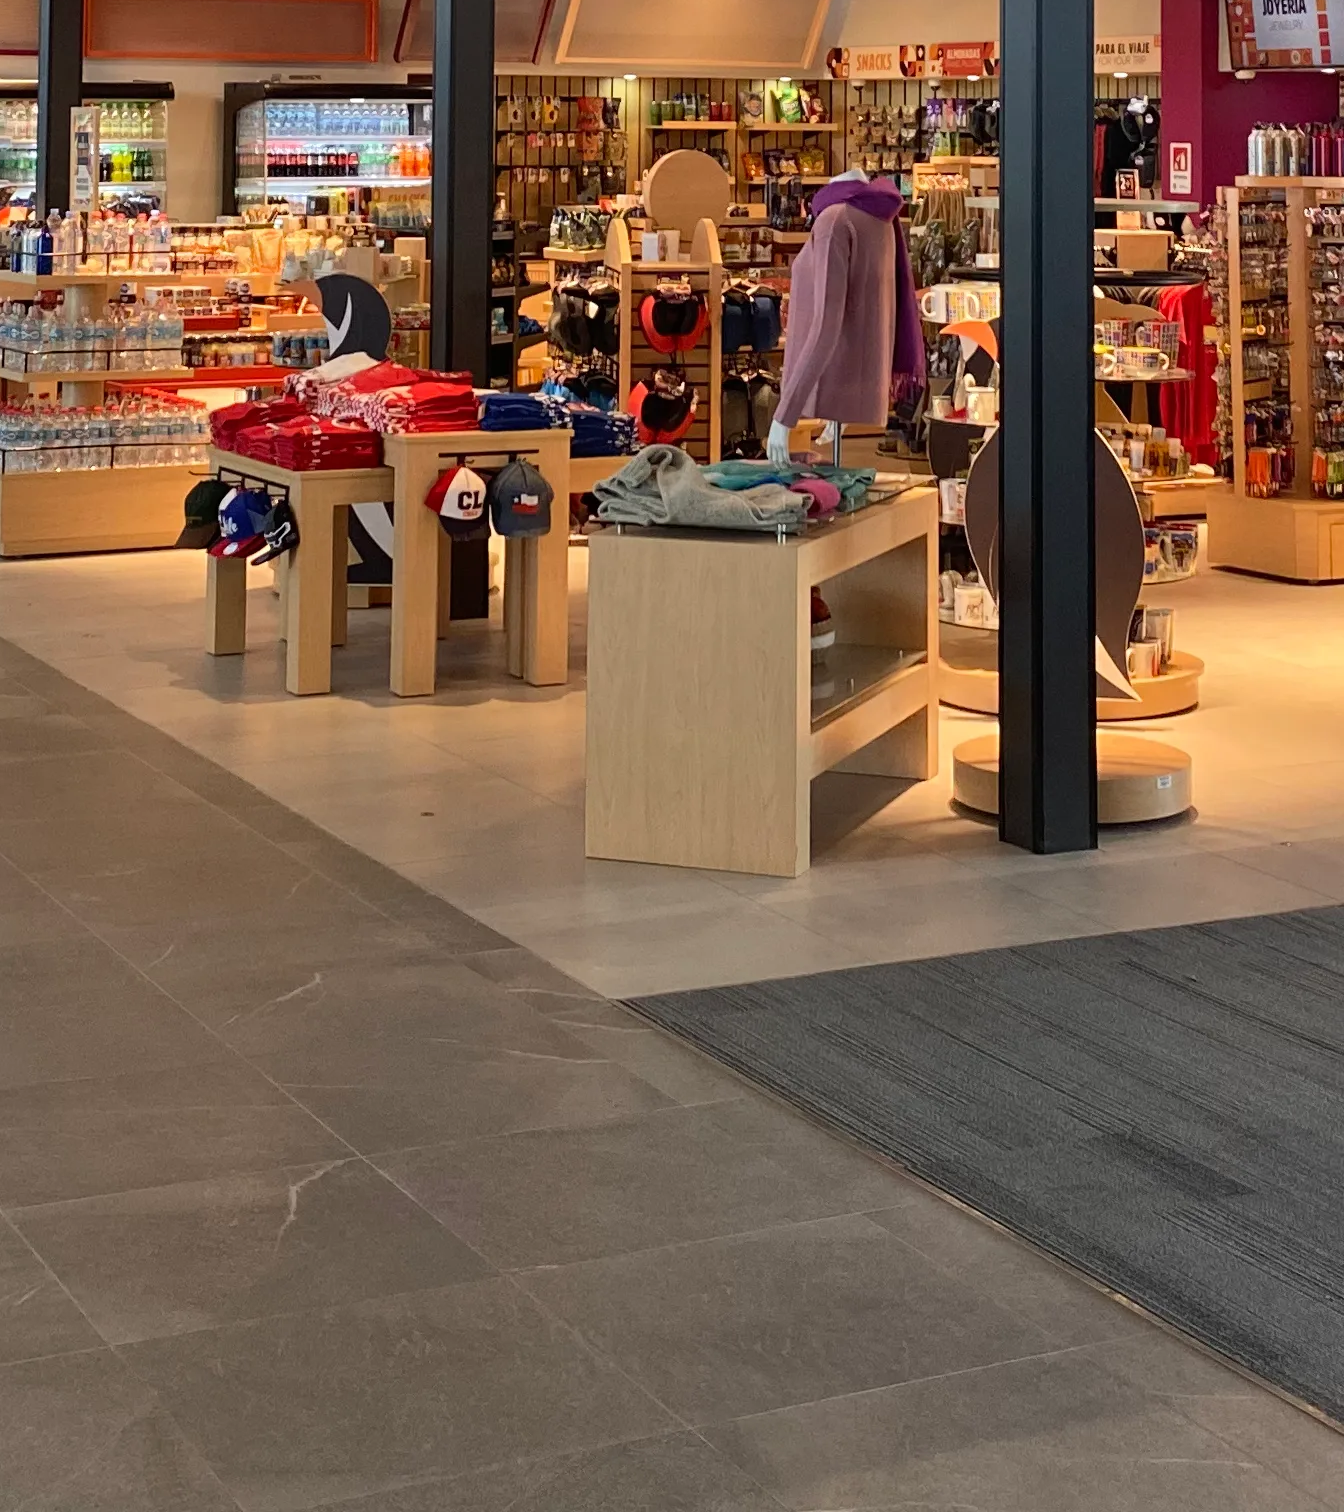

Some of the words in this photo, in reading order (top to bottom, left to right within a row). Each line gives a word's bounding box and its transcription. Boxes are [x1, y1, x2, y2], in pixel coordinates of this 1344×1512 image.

[1096, 43, 1115, 55] PARA
[1117, 43, 1126, 55] EL
[1128, 42, 1150, 54] VIAJE
[856, 53, 893, 71] SNACKS
[458, 491, 483, 510] CL
